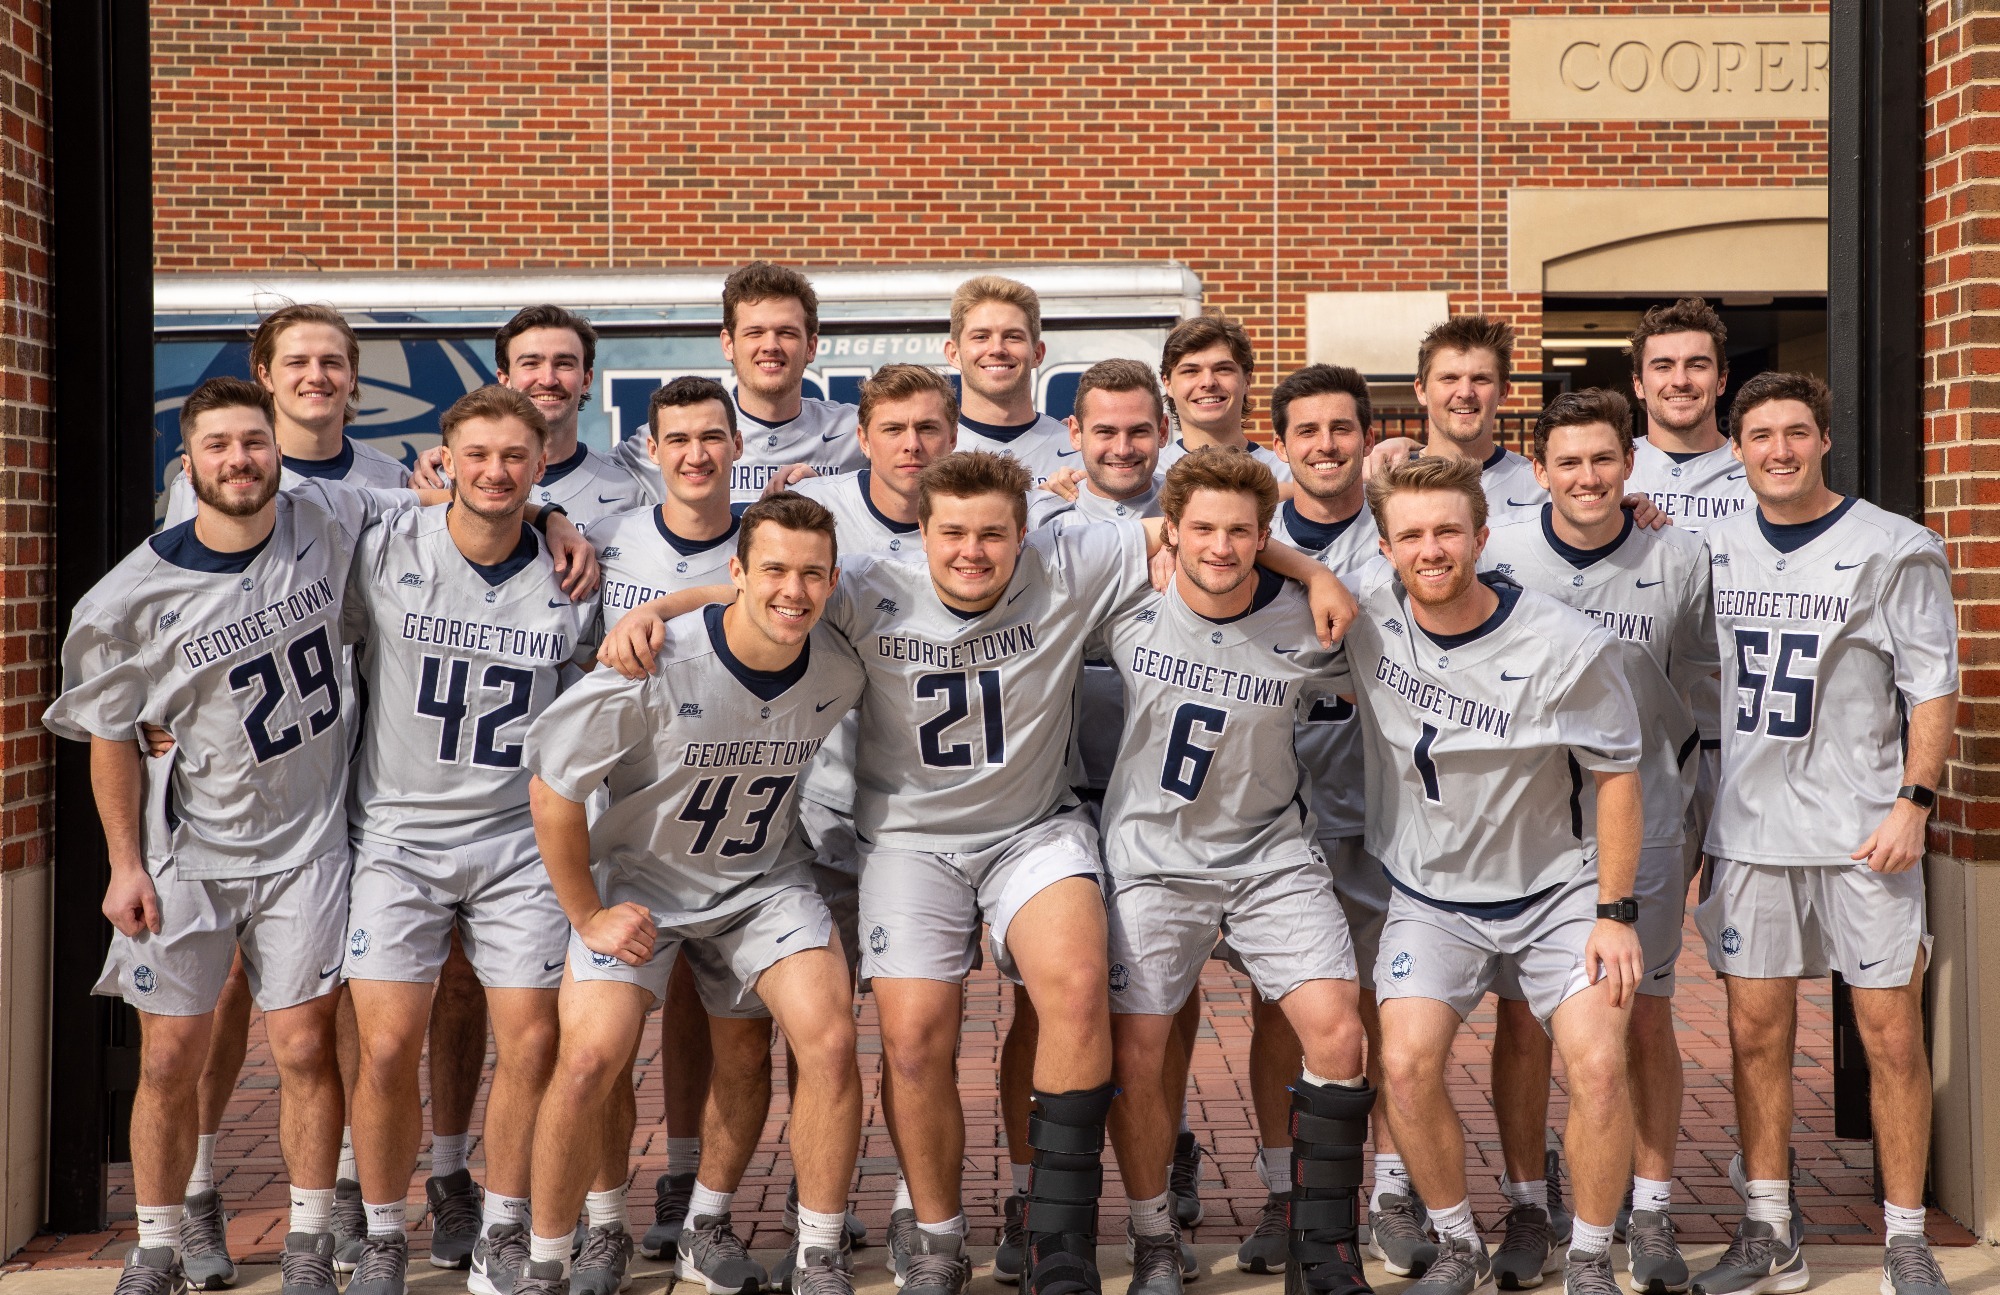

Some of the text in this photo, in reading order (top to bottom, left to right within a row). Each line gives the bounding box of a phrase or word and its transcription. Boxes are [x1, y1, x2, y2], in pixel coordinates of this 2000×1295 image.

[1559, 40, 1829, 94] COOPER
[817, 337, 948, 355] ORGETOW
[183, 576, 335, 669] GEORGETOWN
[402, 612, 565, 661] GEORGETOWN
[878, 622, 1036, 668] GEORGETOWN
[1716, 590, 1850, 623] GEORGETOWN
[225, 620, 342, 767] 29
[414, 653, 536, 771] 42
[914, 667, 1006, 770] 21
[1131, 646, 1290, 707] GEORGETOWN
[1375, 655, 1511, 740] GEORGETOWN
[1733, 625, 1822, 741] 55
[1160, 700, 1231, 803] 6
[1413, 721, 1442, 805] 1
[675, 772, 798, 858] 43
